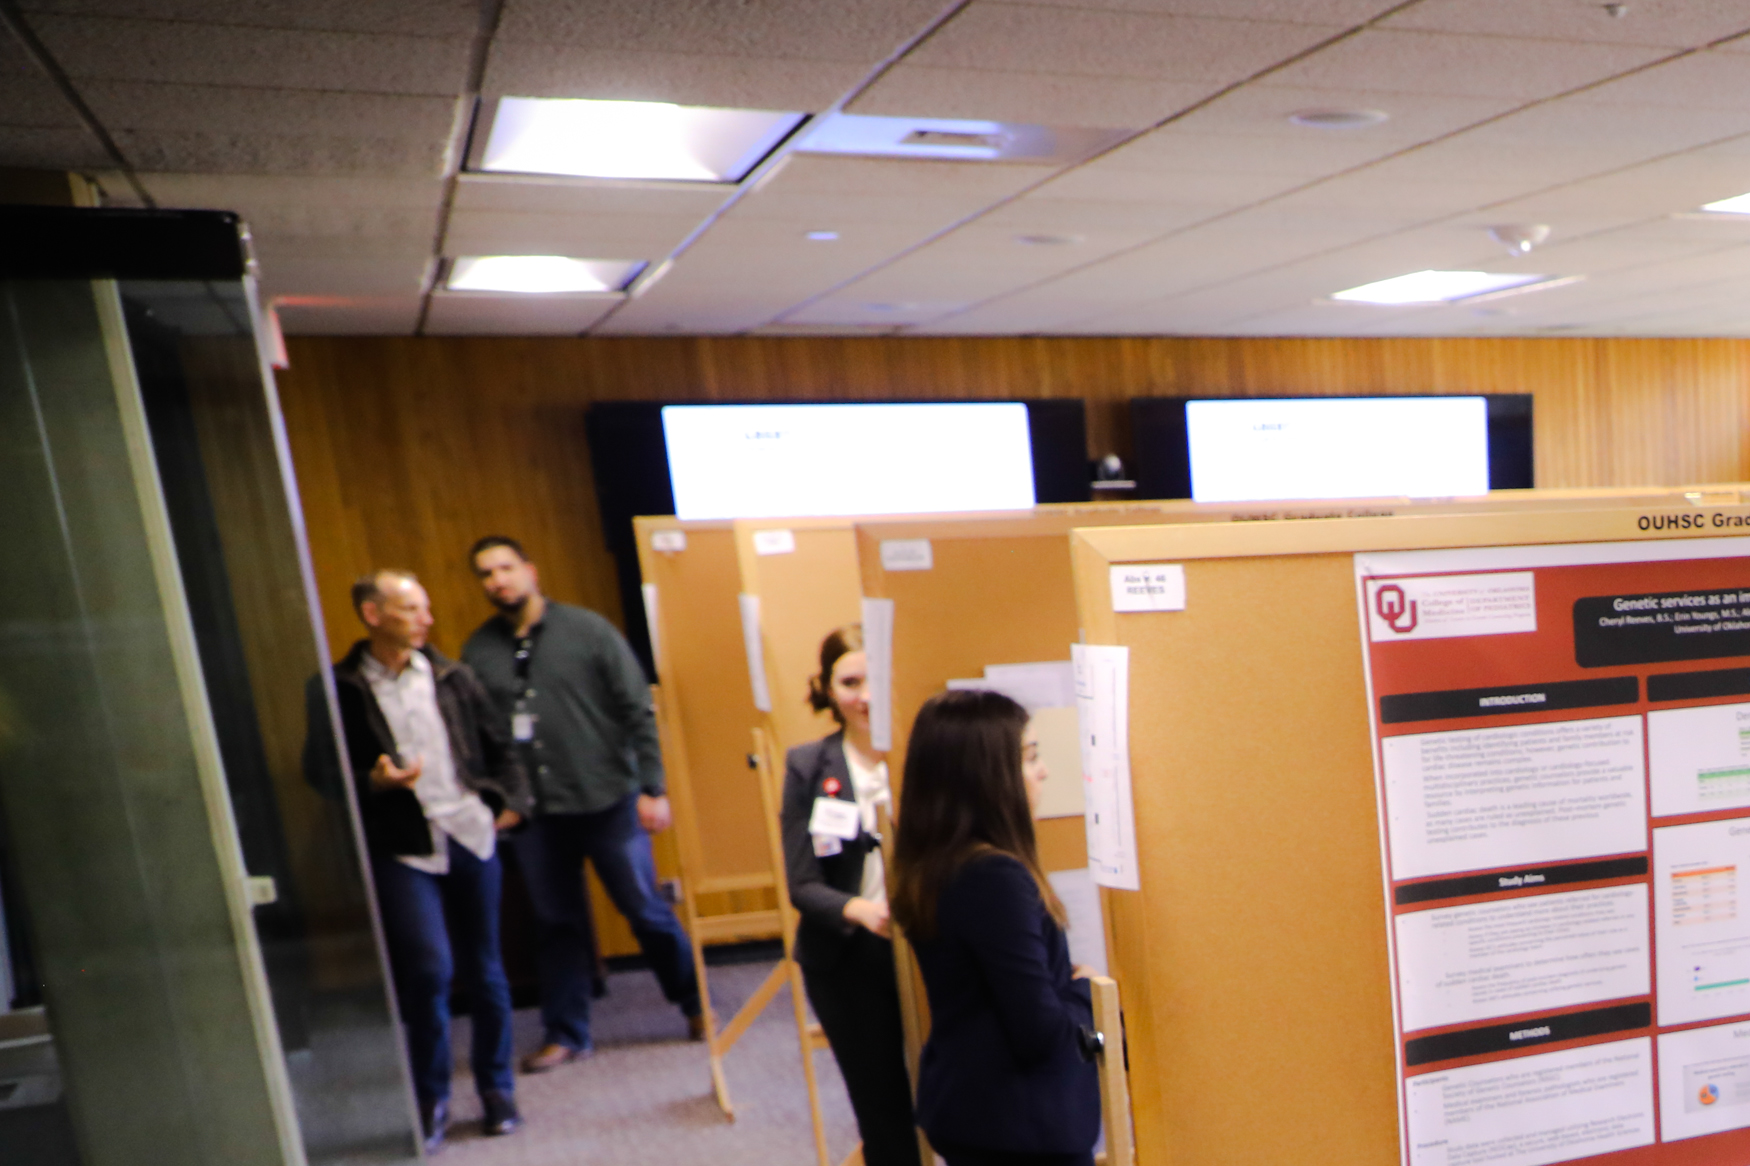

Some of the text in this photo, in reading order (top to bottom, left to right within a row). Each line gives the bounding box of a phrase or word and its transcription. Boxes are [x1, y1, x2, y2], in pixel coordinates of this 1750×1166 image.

[1638, 514, 1704, 530] OUHSC
[1612, 596, 1658, 612] Genetic
[1660, 592, 1706, 609] services
[1707, 593, 1720, 605] as
[1722, 592, 1737, 604] an
[1478, 692, 1547, 707] INTRODUCTION
[1499, 873, 1546, 887] Study Aims
[1509, 1025, 1551, 1041] METHODS
